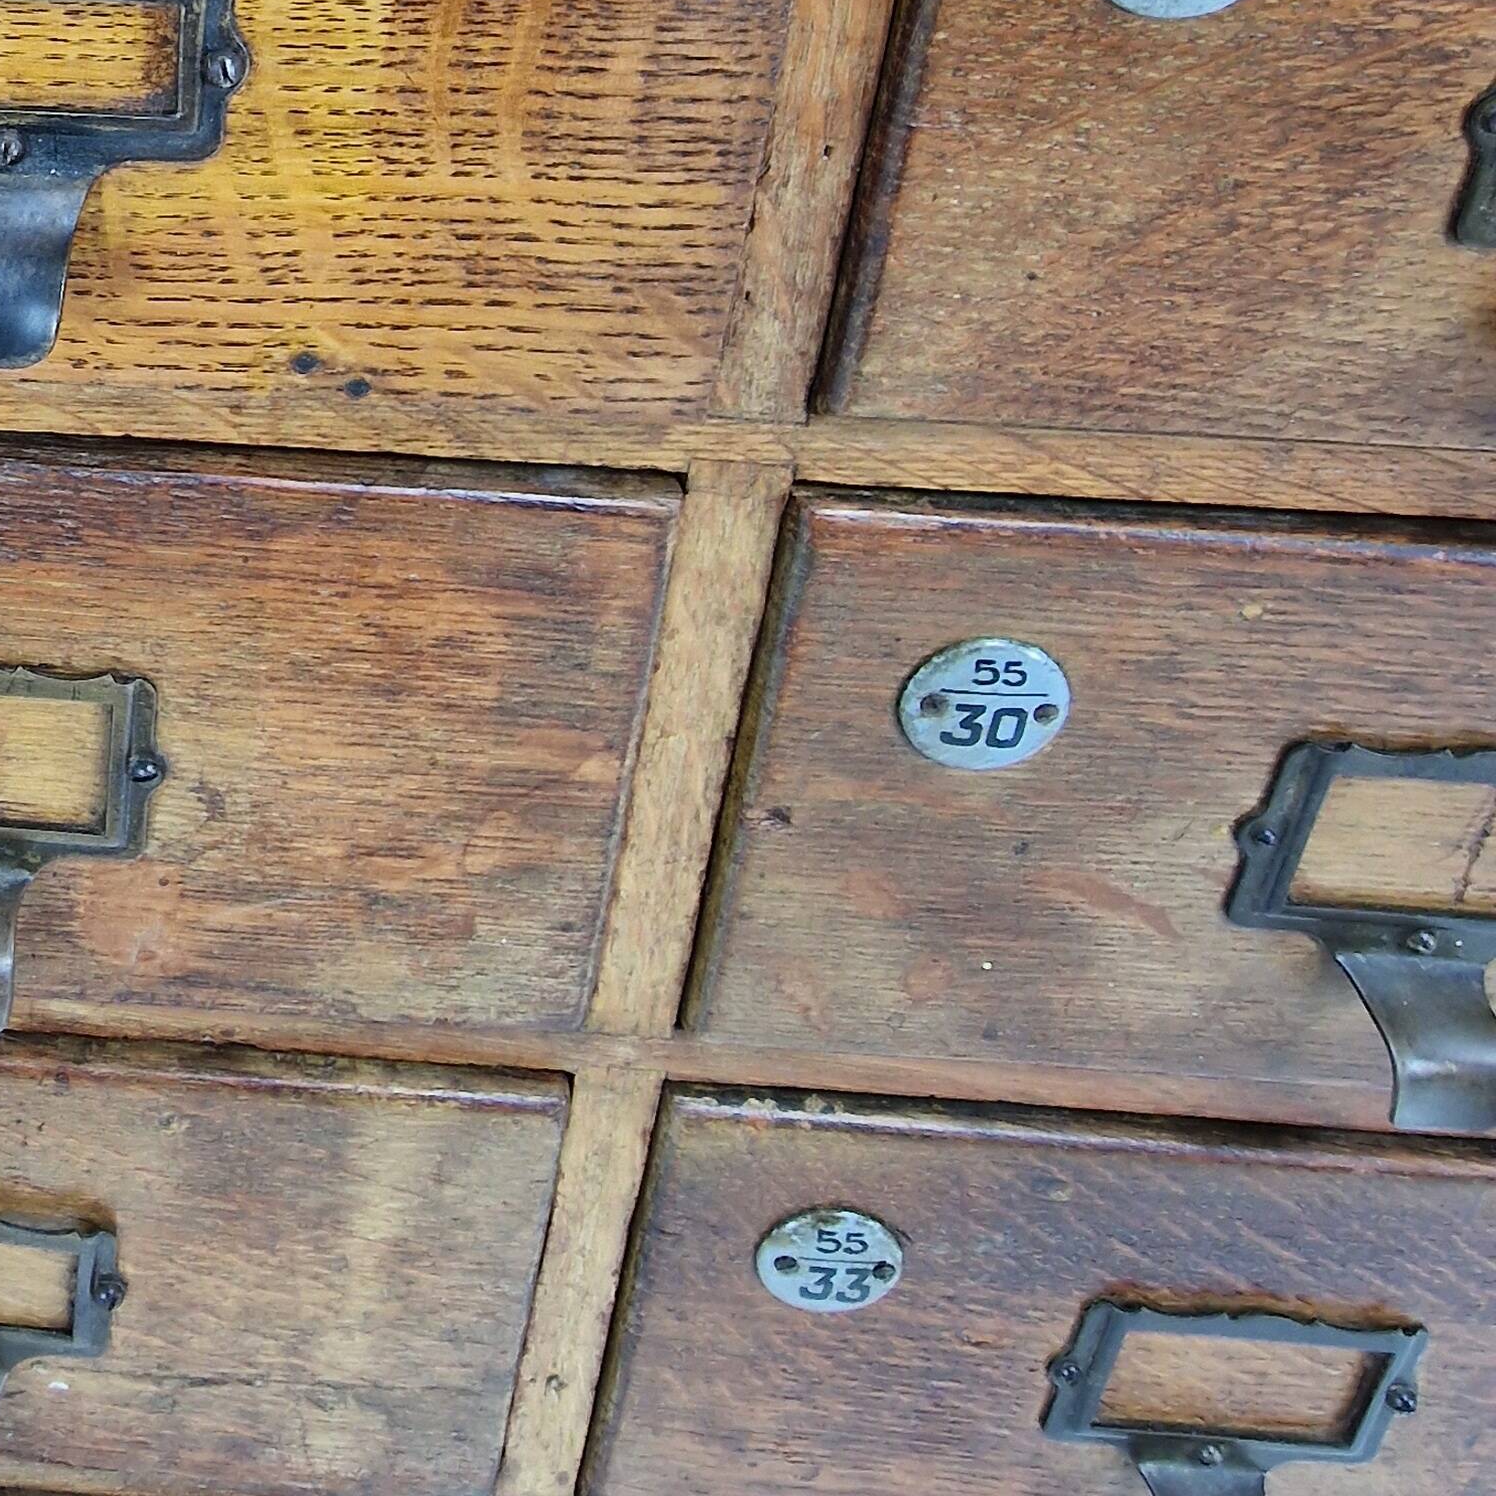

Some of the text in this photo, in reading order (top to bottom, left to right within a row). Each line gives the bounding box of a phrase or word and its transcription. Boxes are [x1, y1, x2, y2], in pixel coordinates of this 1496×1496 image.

[971, 659, 1028, 687] 55
[939, 703, 1029, 749] 30
[815, 1228, 870, 1255] 55
[799, 1266, 872, 1304] 33
